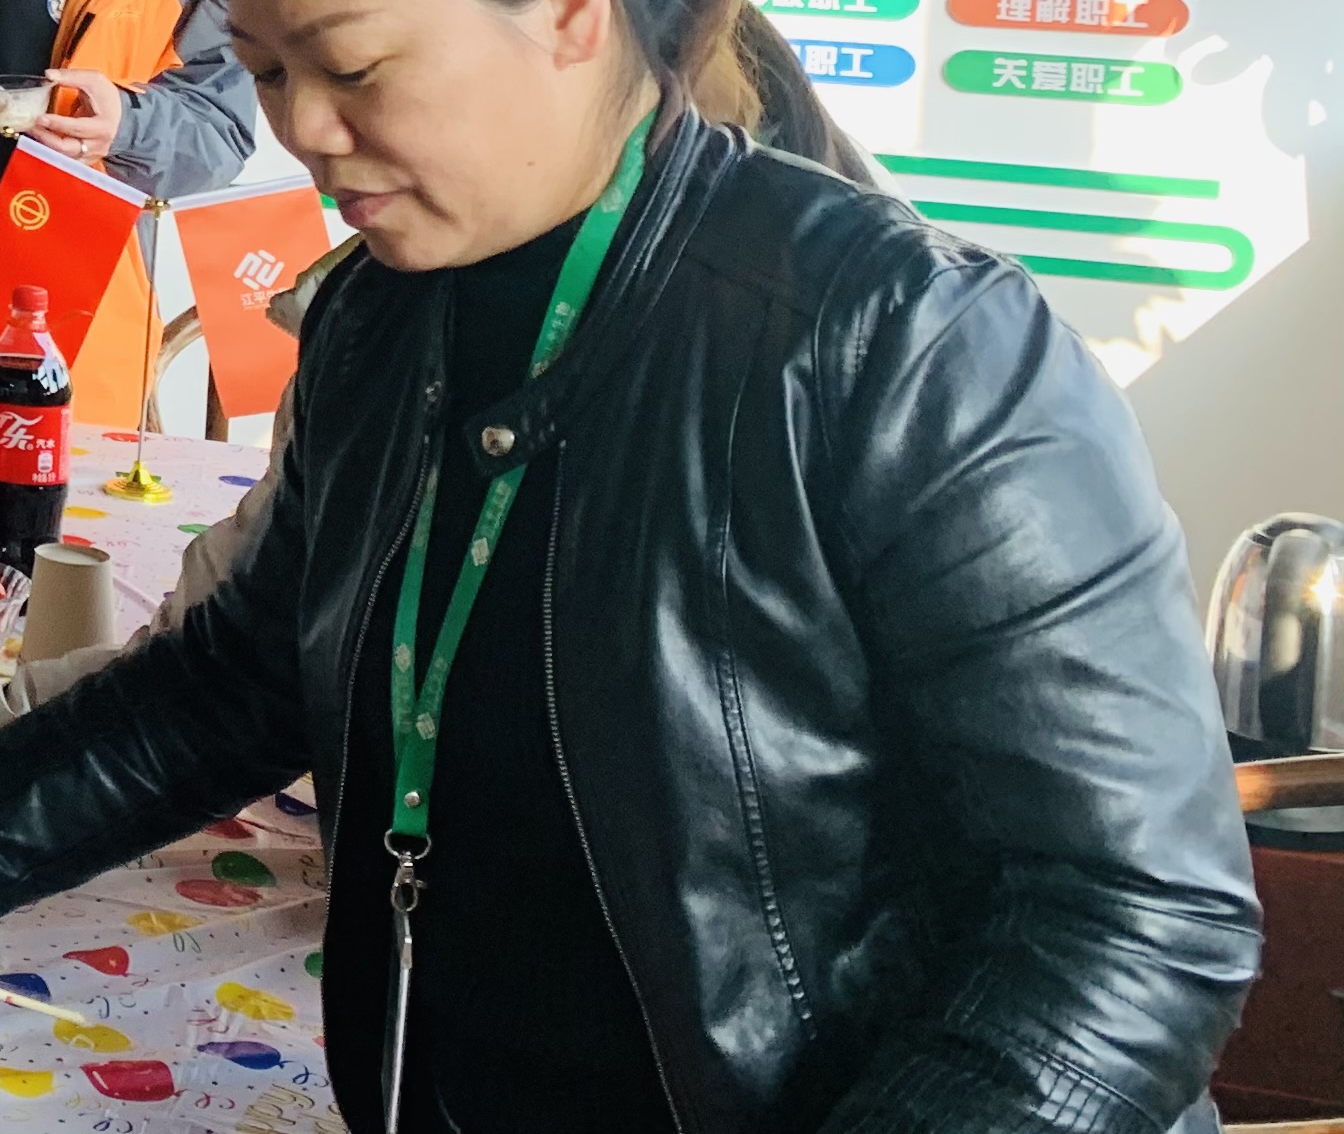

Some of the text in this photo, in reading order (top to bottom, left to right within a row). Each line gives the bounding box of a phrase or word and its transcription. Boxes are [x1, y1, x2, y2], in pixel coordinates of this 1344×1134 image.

[792, 43, 875, 79] 职工
[991, 57, 1145, 98] 关爱职工
